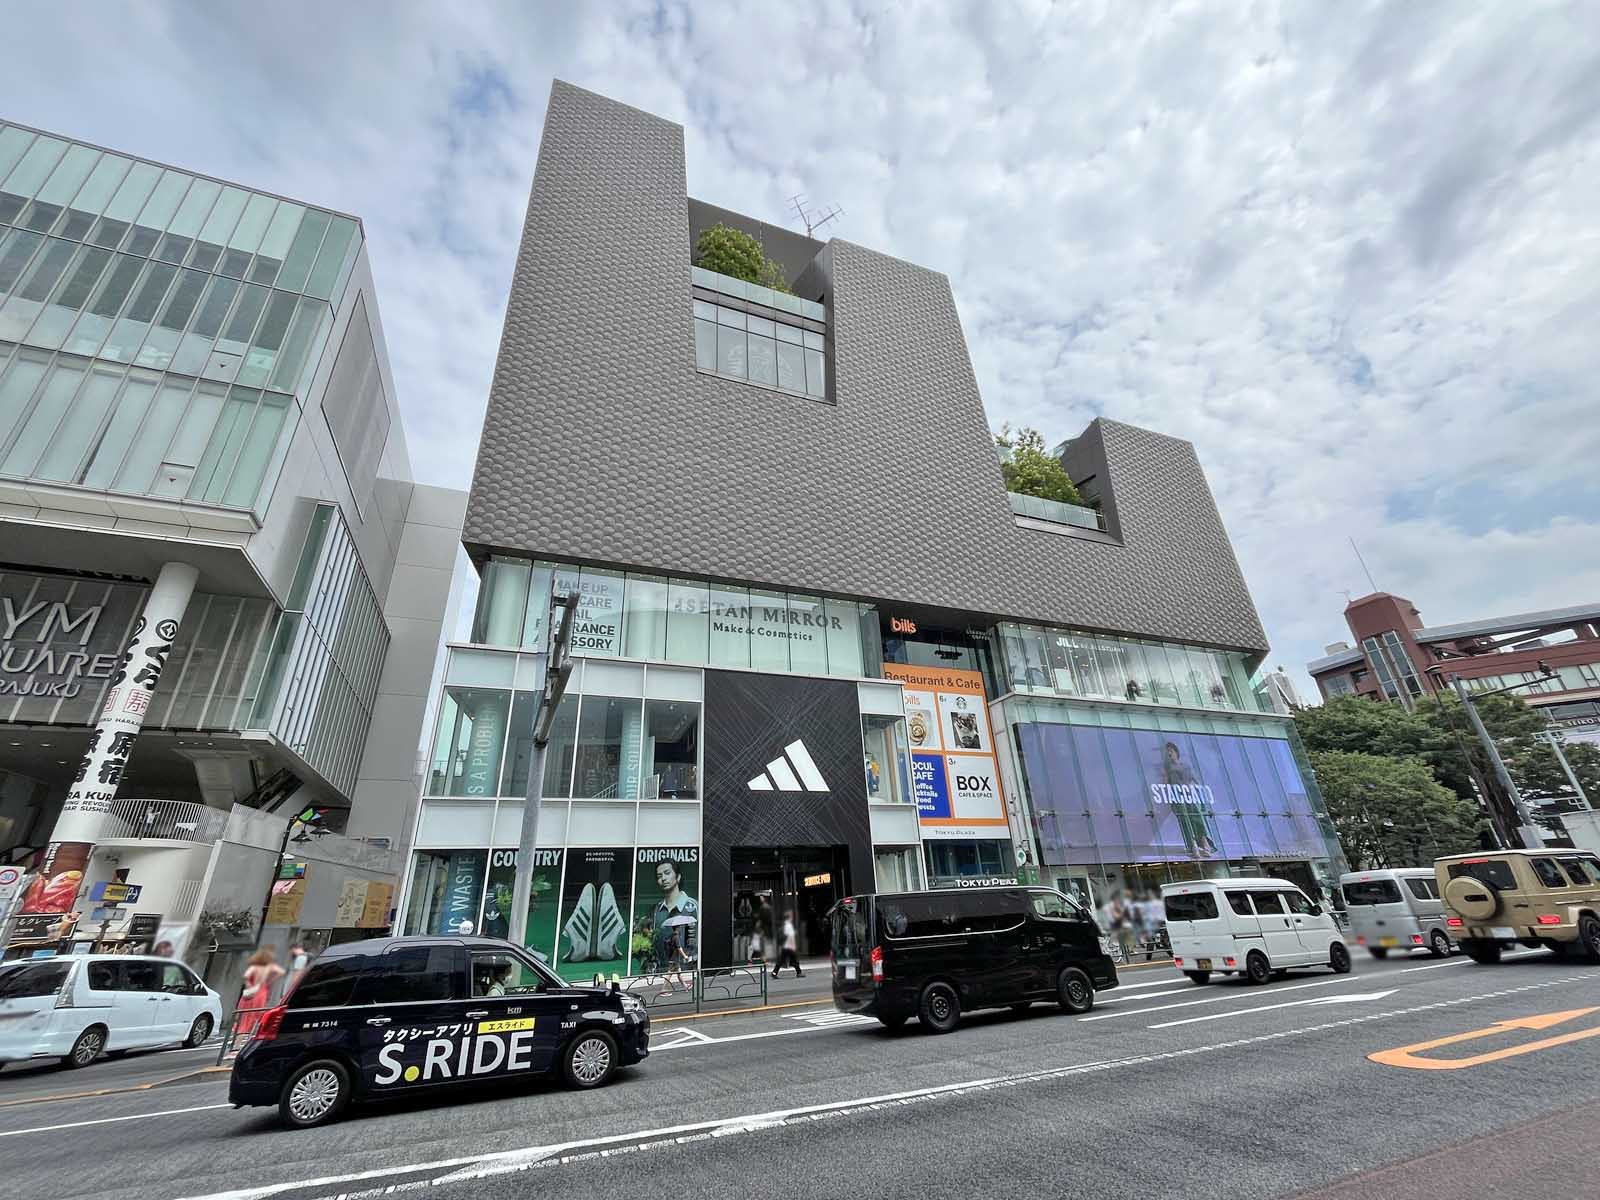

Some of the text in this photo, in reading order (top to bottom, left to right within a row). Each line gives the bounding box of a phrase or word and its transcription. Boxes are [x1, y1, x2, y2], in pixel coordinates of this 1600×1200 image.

[592, 583, 608, 594] UP
[580, 596, 612, 608] CARE
[574, 609, 592, 620] AIL
[713, 622, 744, 634] Make
[757, 627, 813, 641] Cosmetics
[891, 616, 916, 634] bills
[1055, 637, 1079, 648] JILL
[0, 646, 120, 678] UARE
[885, 671, 981, 690] Restaurant & Cafe
[956, 775, 991, 792] BOX
[493, 850, 562, 868] COTRY
[638, 848, 698, 863] ORIGINALS
[955, 879, 989, 888] TOKYU
[383, 1022, 474, 1043] タクシーアプリ
[488, 1020, 526, 1031] エスライド
[560, 1021, 577, 1029] TAXI
